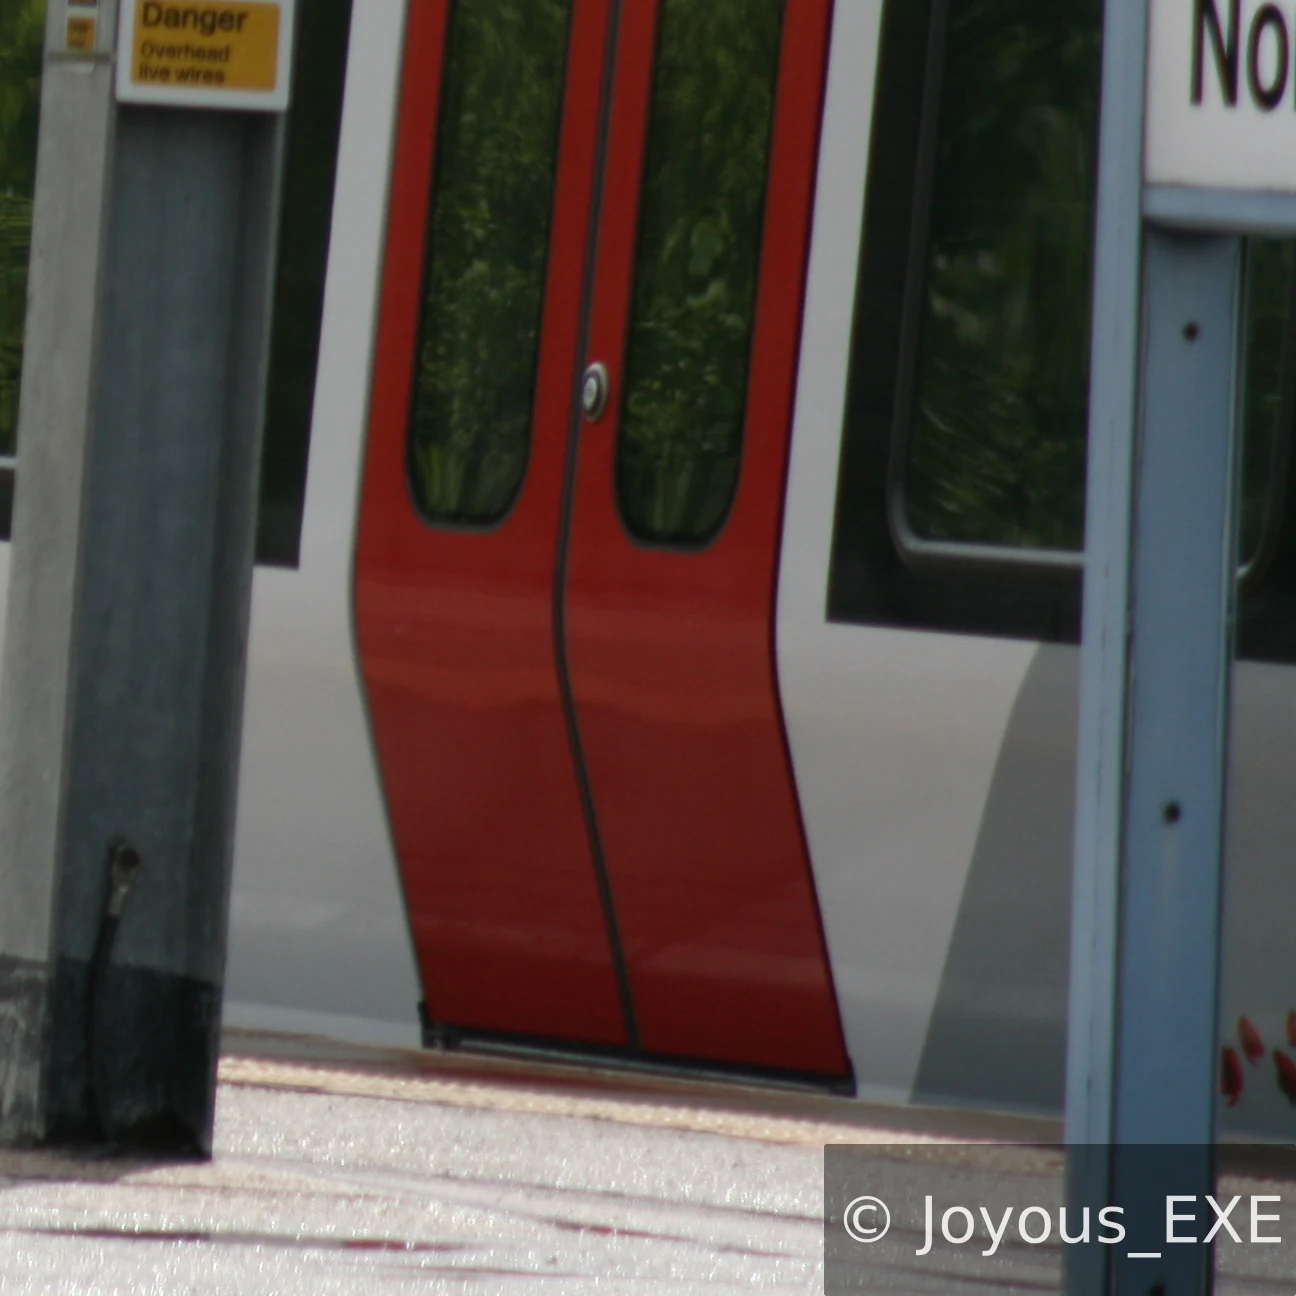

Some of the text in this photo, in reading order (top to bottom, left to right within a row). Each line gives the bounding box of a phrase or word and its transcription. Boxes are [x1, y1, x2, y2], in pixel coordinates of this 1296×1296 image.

[142, 1, 249, 36] Danger
[141, 41, 231, 64] Overhead
[139, 63, 225, 84] live wires
